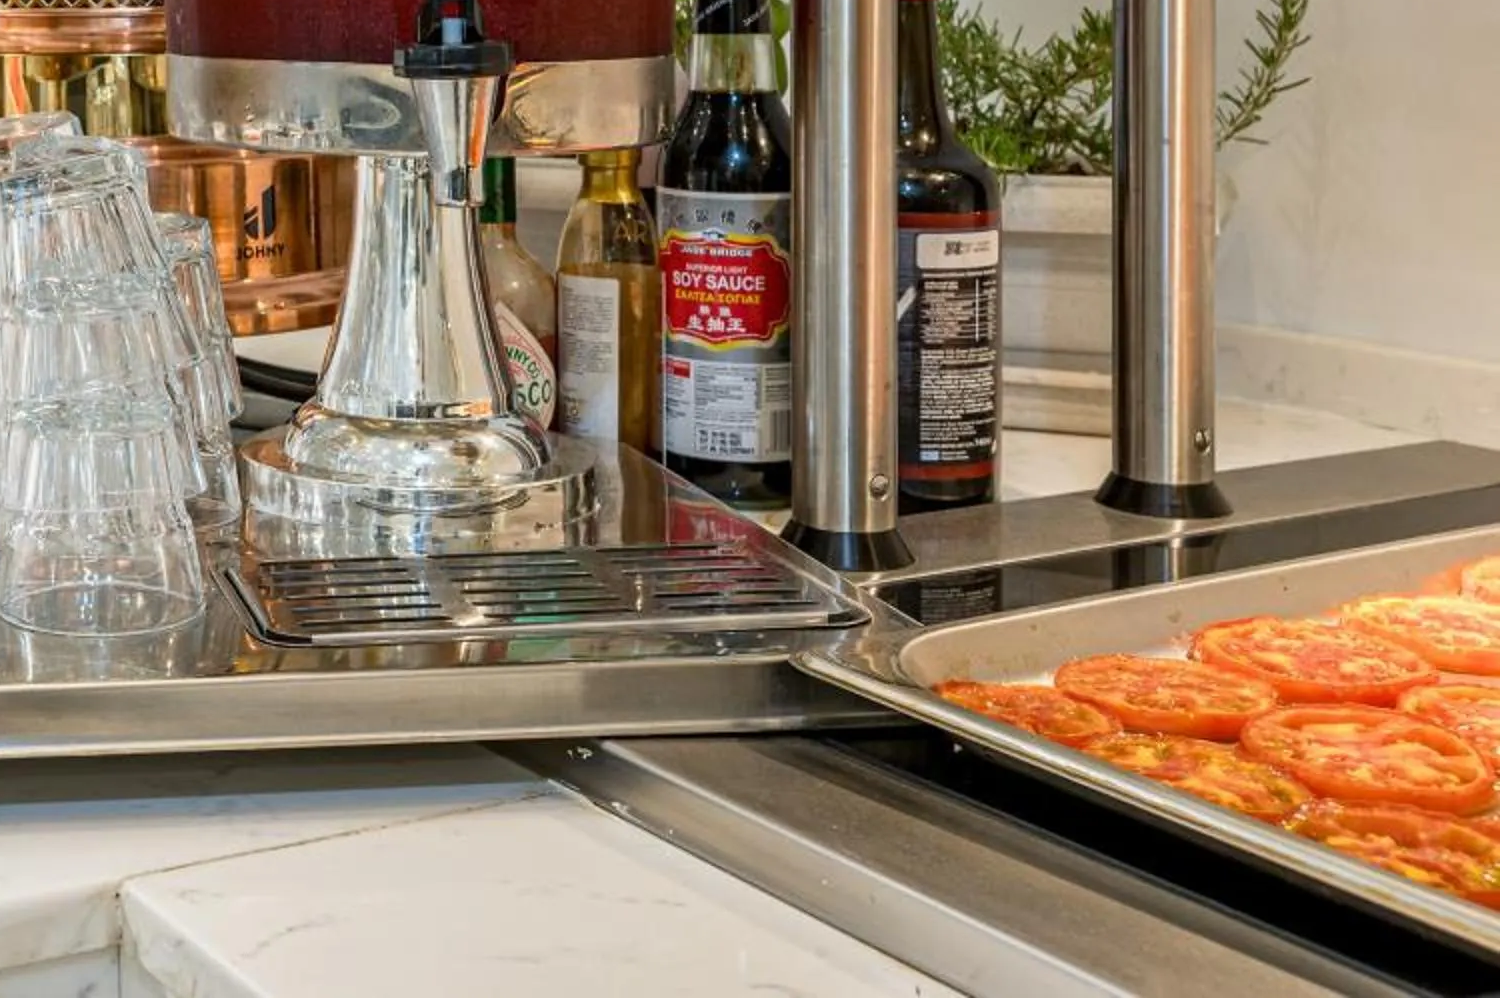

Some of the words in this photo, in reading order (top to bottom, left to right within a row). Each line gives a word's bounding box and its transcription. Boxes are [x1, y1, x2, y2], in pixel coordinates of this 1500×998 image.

[236, 243, 285, 261] JOHNY
[709, 247, 753, 258] BRIDGE
[724, 265, 748, 275] LIGHT
[672, 270, 702, 287] SOY
[705, 273, 766, 292] SAUCE
[515, 379, 553, 407] SCO
